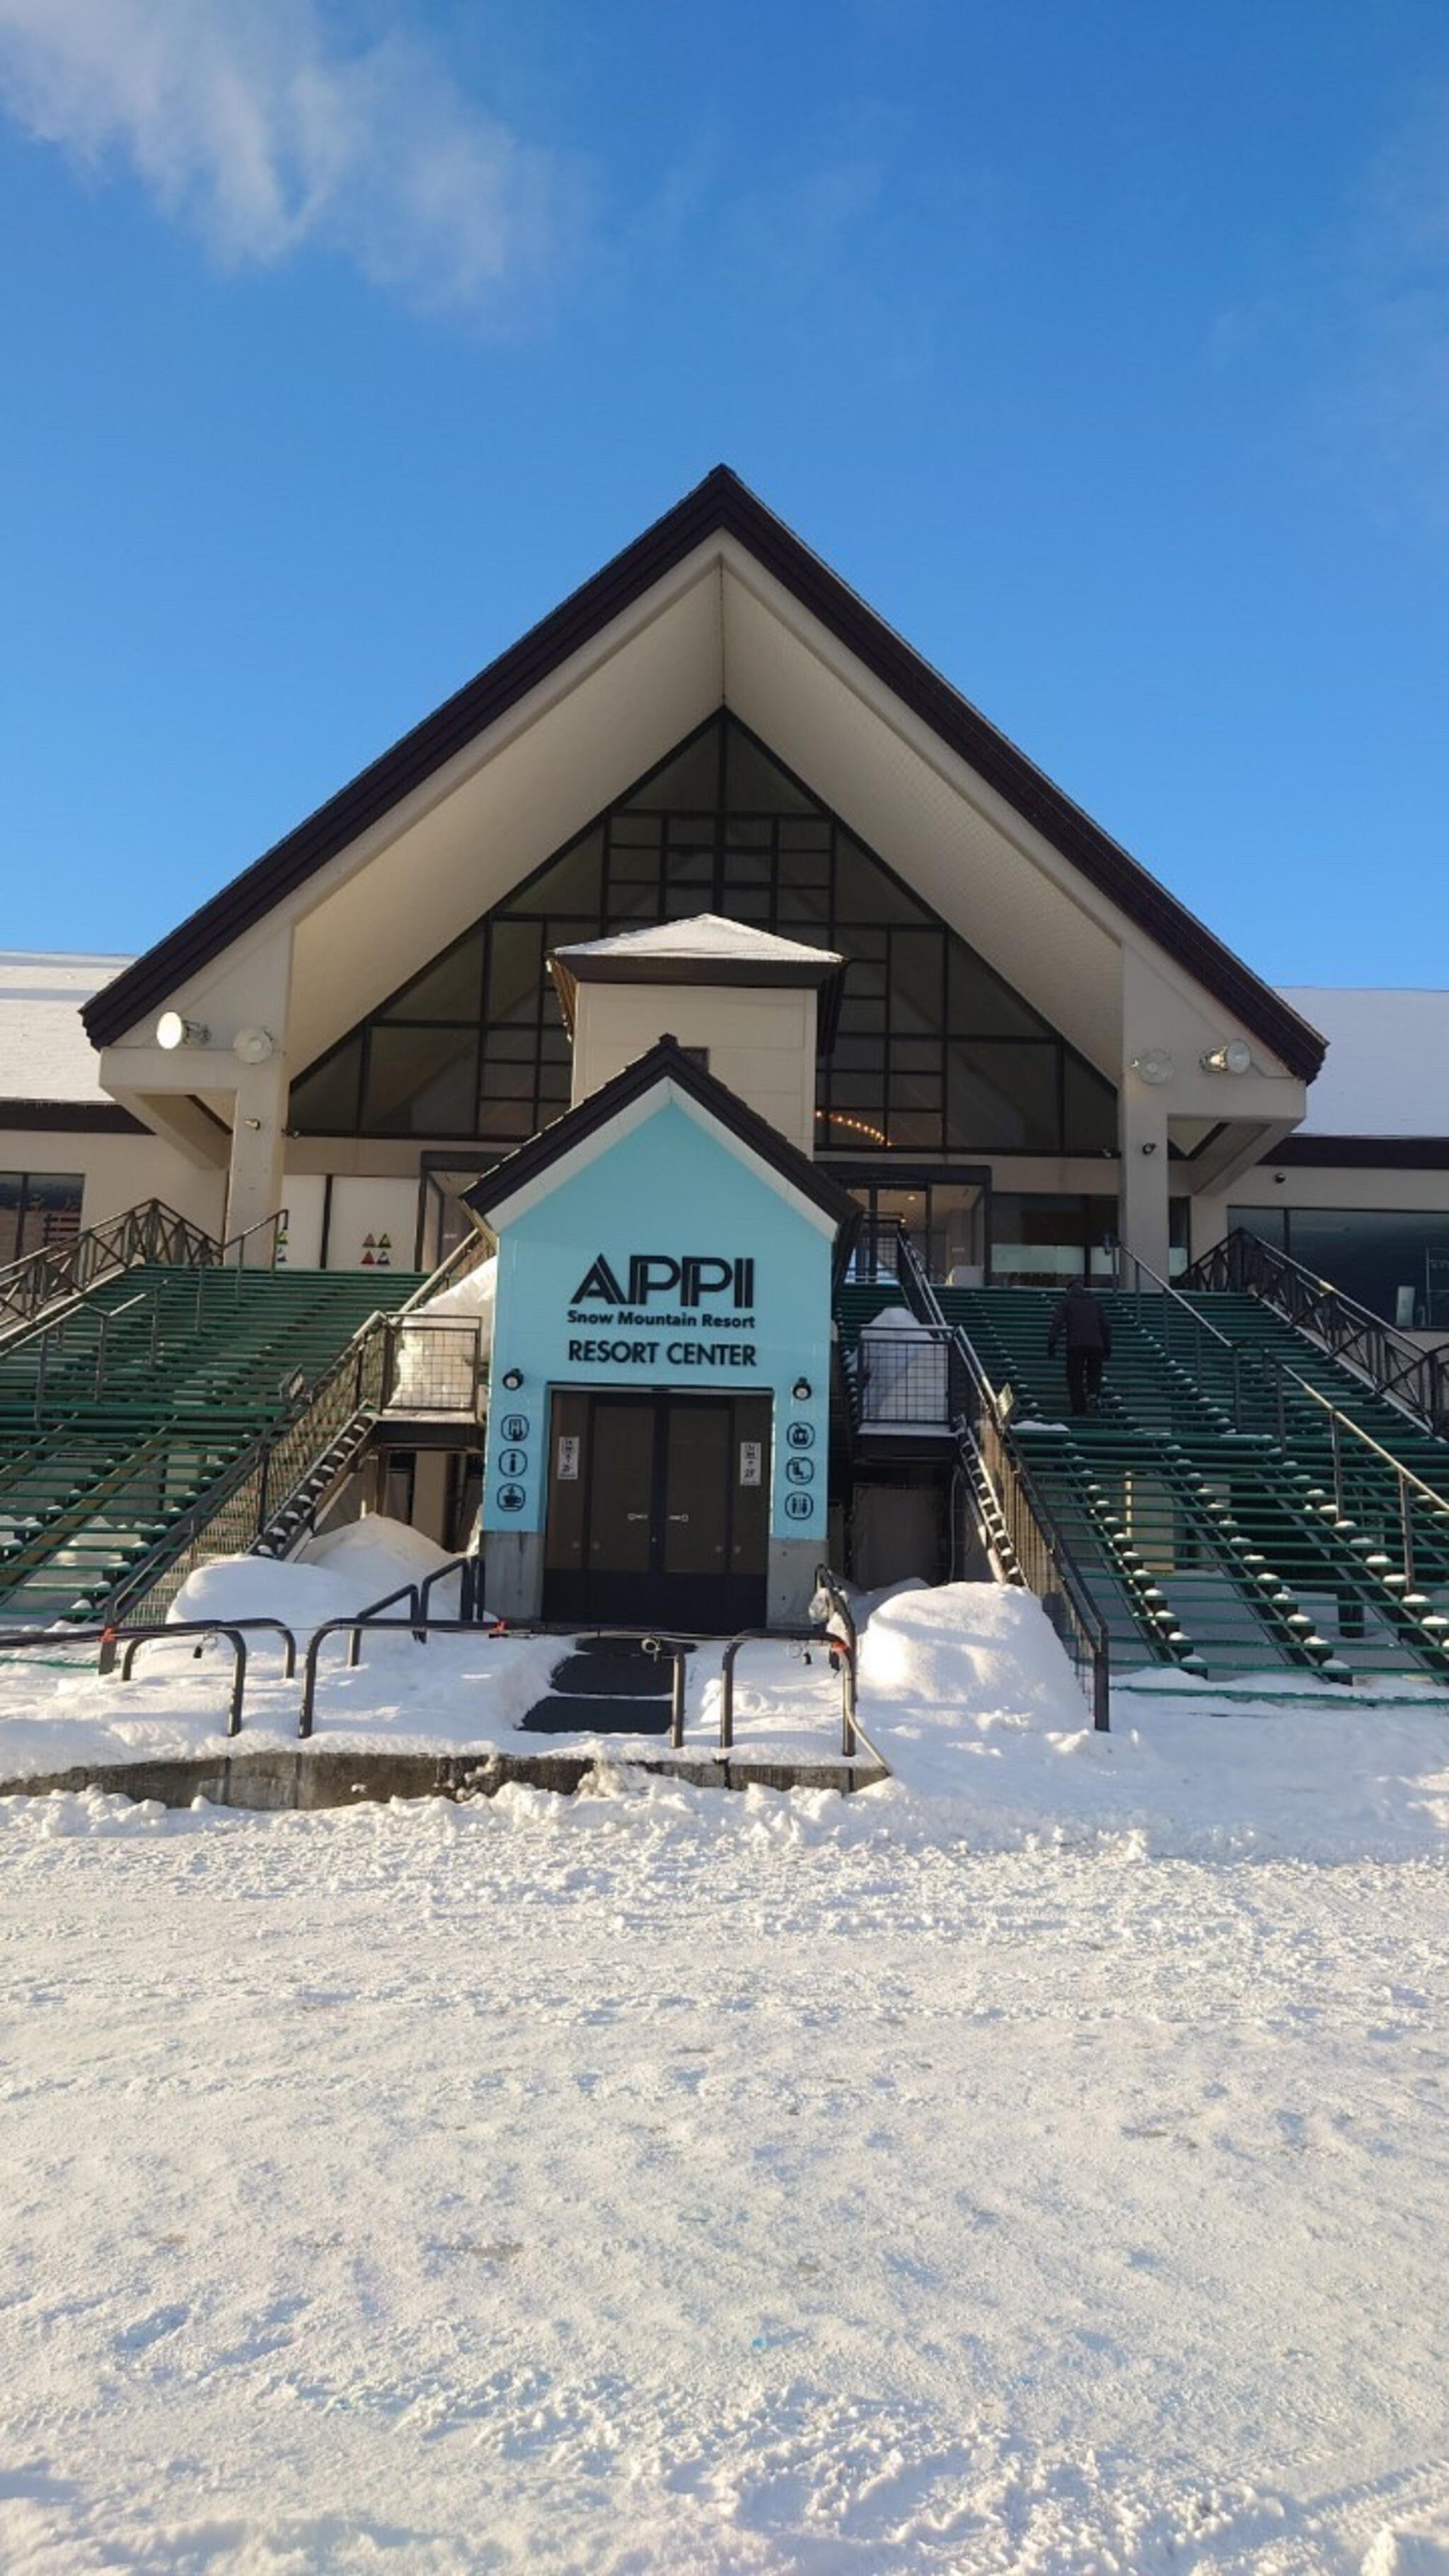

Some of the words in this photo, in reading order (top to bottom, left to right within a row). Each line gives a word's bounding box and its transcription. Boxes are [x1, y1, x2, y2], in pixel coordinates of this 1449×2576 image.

[570, 1253, 754, 1307] APPI
[567, 1310, 613, 1324] Snow
[618, 1312, 697, 1327] Mountain
[702, 1314, 755, 1328] Resort
[569, 1340, 660, 1363] RESORT
[666, 1342, 756, 1366] CENTER
